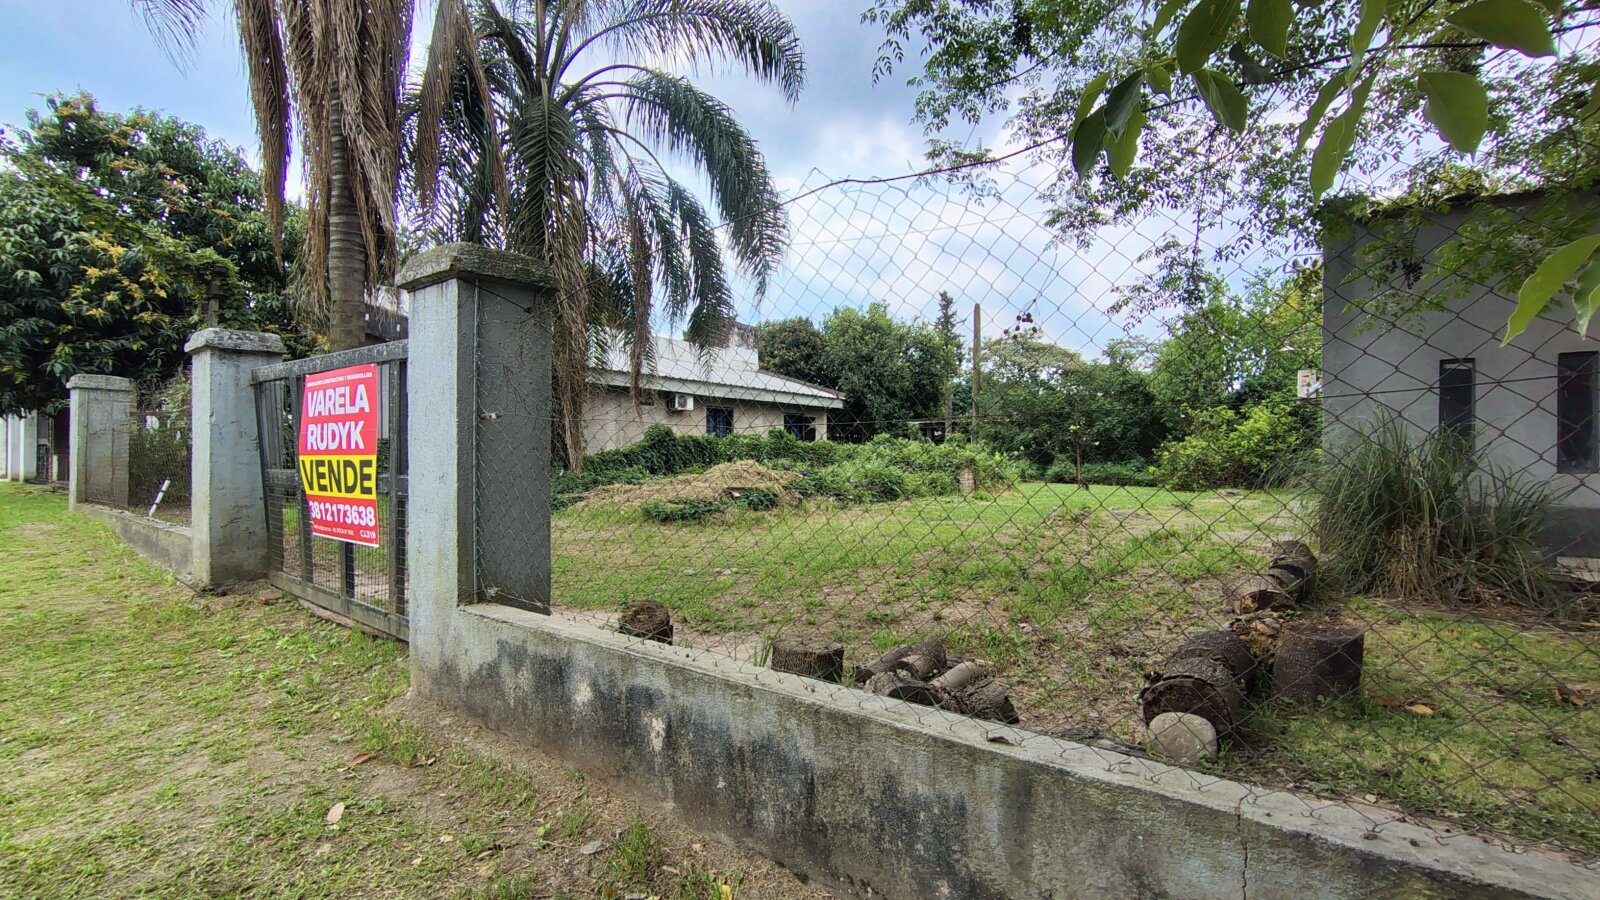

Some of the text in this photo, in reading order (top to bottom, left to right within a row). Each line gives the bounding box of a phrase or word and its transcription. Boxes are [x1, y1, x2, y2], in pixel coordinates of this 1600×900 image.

[307, 384, 370, 418] VARELA
[306, 420, 365, 450] RUDYK
[301, 459, 373, 495] VENDE
[309, 500, 376, 527] 3812173638
